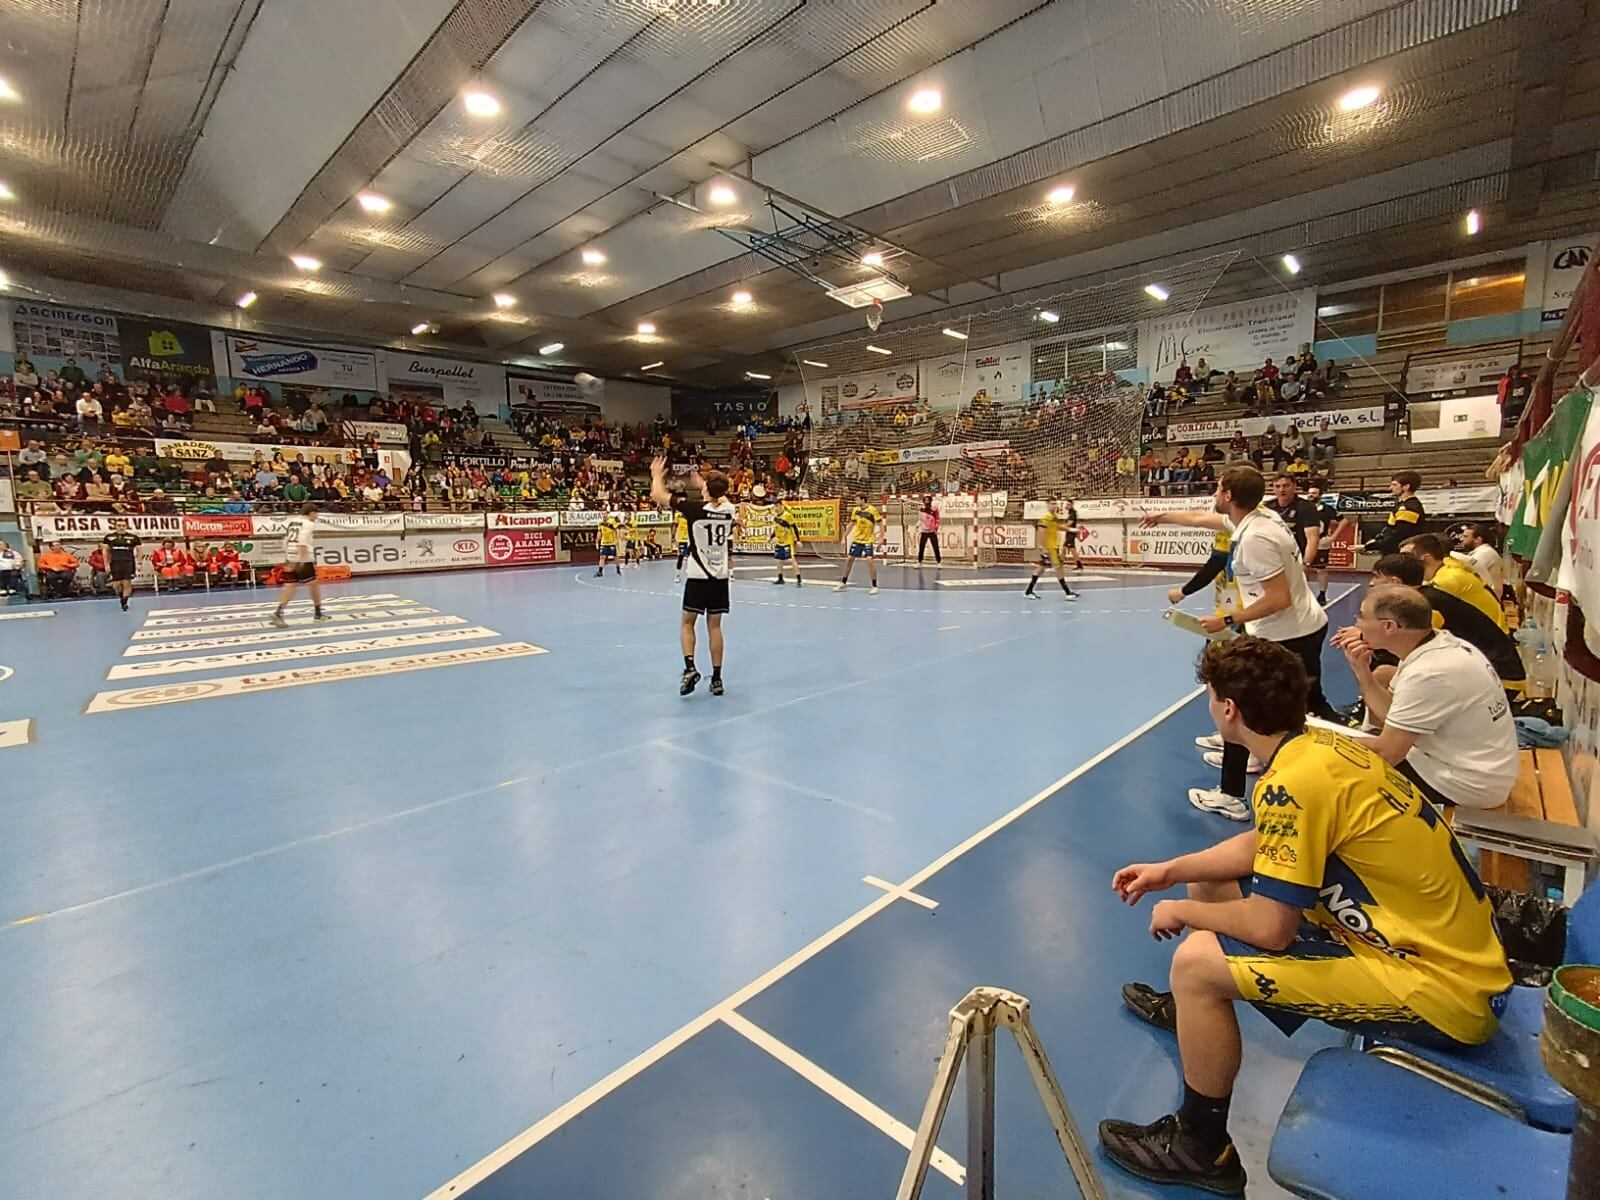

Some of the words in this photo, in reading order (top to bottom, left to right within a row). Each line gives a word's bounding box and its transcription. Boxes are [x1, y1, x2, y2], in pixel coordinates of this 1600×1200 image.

[1248, 312, 1296, 326] Tradicional
[252, 354, 307, 375] HERNANDO
[408, 360, 474, 379] Burpellet
[714, 401, 767, 412] TASIO
[175, 448, 209, 459] SANZ
[459, 456, 506, 468] PORTILLO
[54, 518, 101, 531] CASA
[108, 517, 181, 531] SLVIANO
[495, 513, 553, 526] Alcampo
[704, 523, 726, 546] 18
[1131, 530, 1166, 538] ALMACEN
[457, 543, 476, 552] KIA
[515, 540, 553, 548] ARANDA
[408, 557, 446, 565] PEUGEOT
[131, 644, 337, 670] CASTILLA
[396, 626, 481, 642] LEON
[240, 663, 376, 685] tubos
[390, 645, 532, 666] aranda
